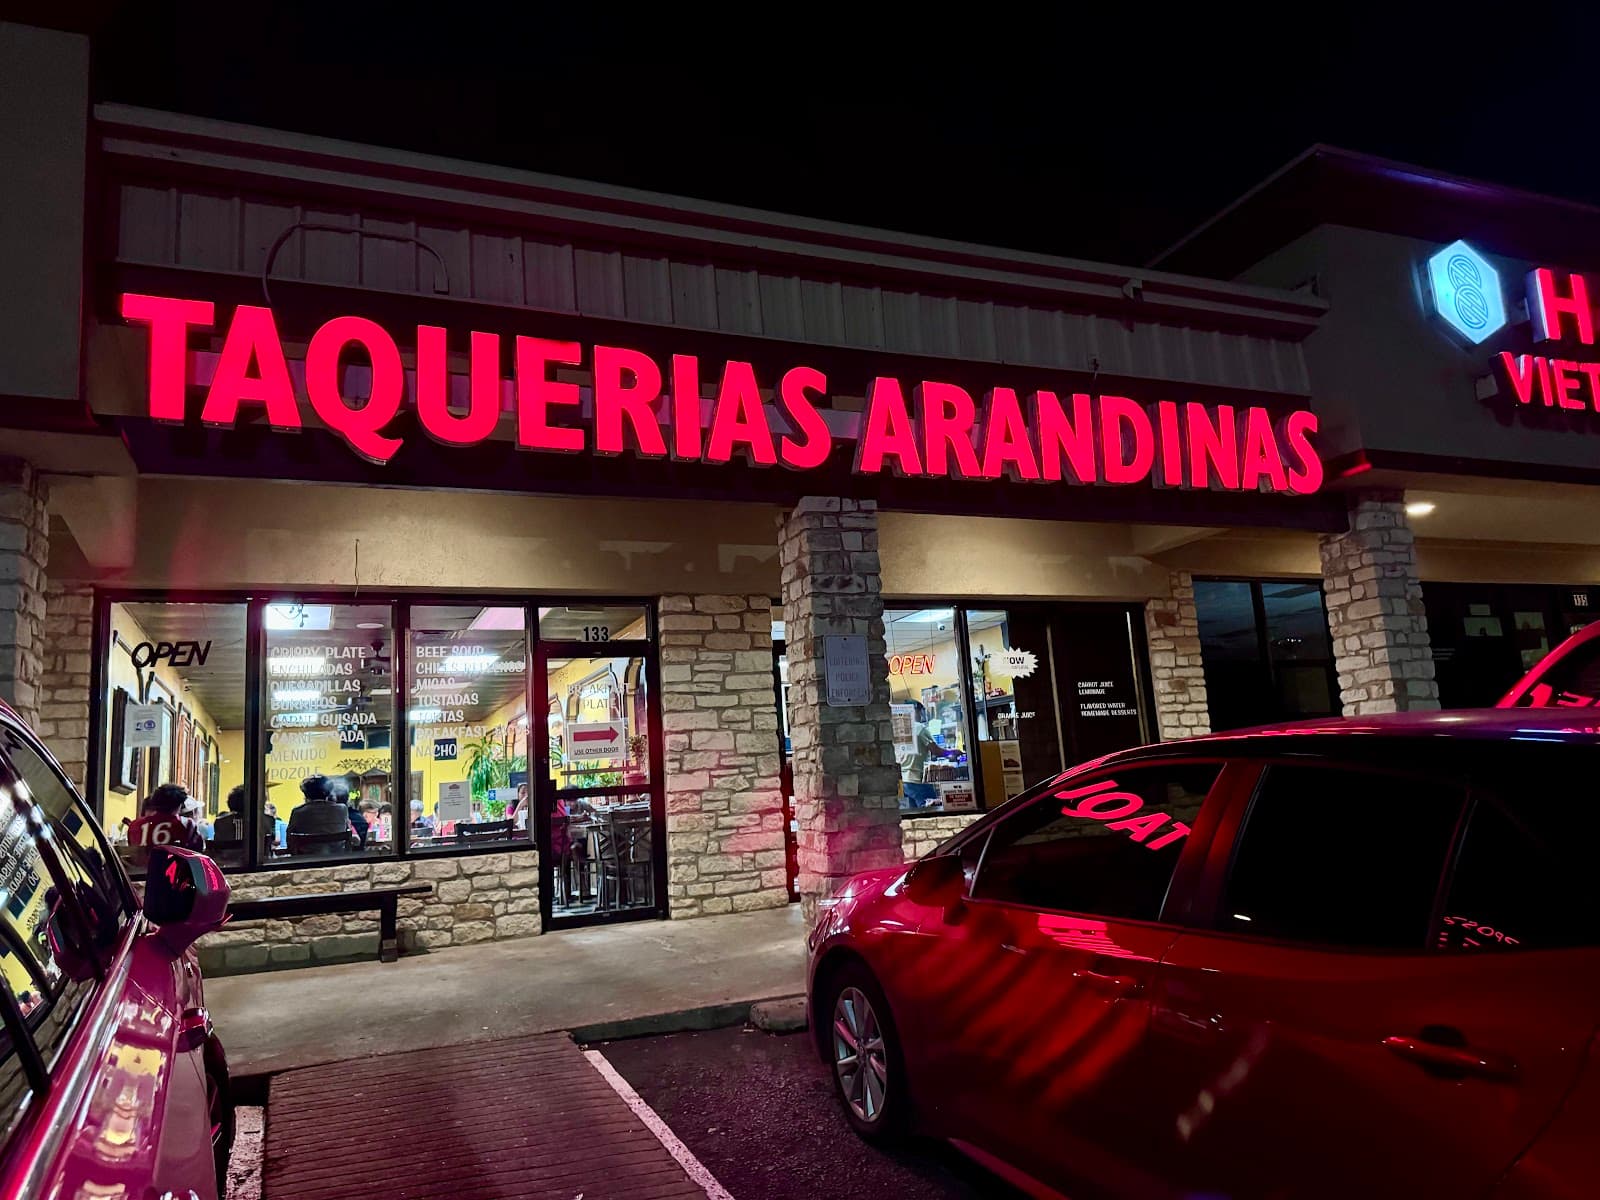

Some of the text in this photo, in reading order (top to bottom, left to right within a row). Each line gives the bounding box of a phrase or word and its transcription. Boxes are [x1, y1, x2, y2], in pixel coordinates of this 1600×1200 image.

[121, 292, 1324, 495] TAQUERIAS ARANDINAS
[583, 626, 609, 641] 133
[132, 640, 212, 668] OPEN
[325, 646, 366, 658] PLATE
[415, 645, 485, 658] BEEF SOUP
[271, 663, 353, 677] ENCHILADAS
[889, 655, 936, 675] OPEN
[270, 679, 361, 693] QUESADILLAS
[416, 692, 479, 706] TOSTADAS
[320, 712, 377, 726] GUISADA
[270, 748, 328, 763] MENUDO
[140, 821, 173, 847] 16
